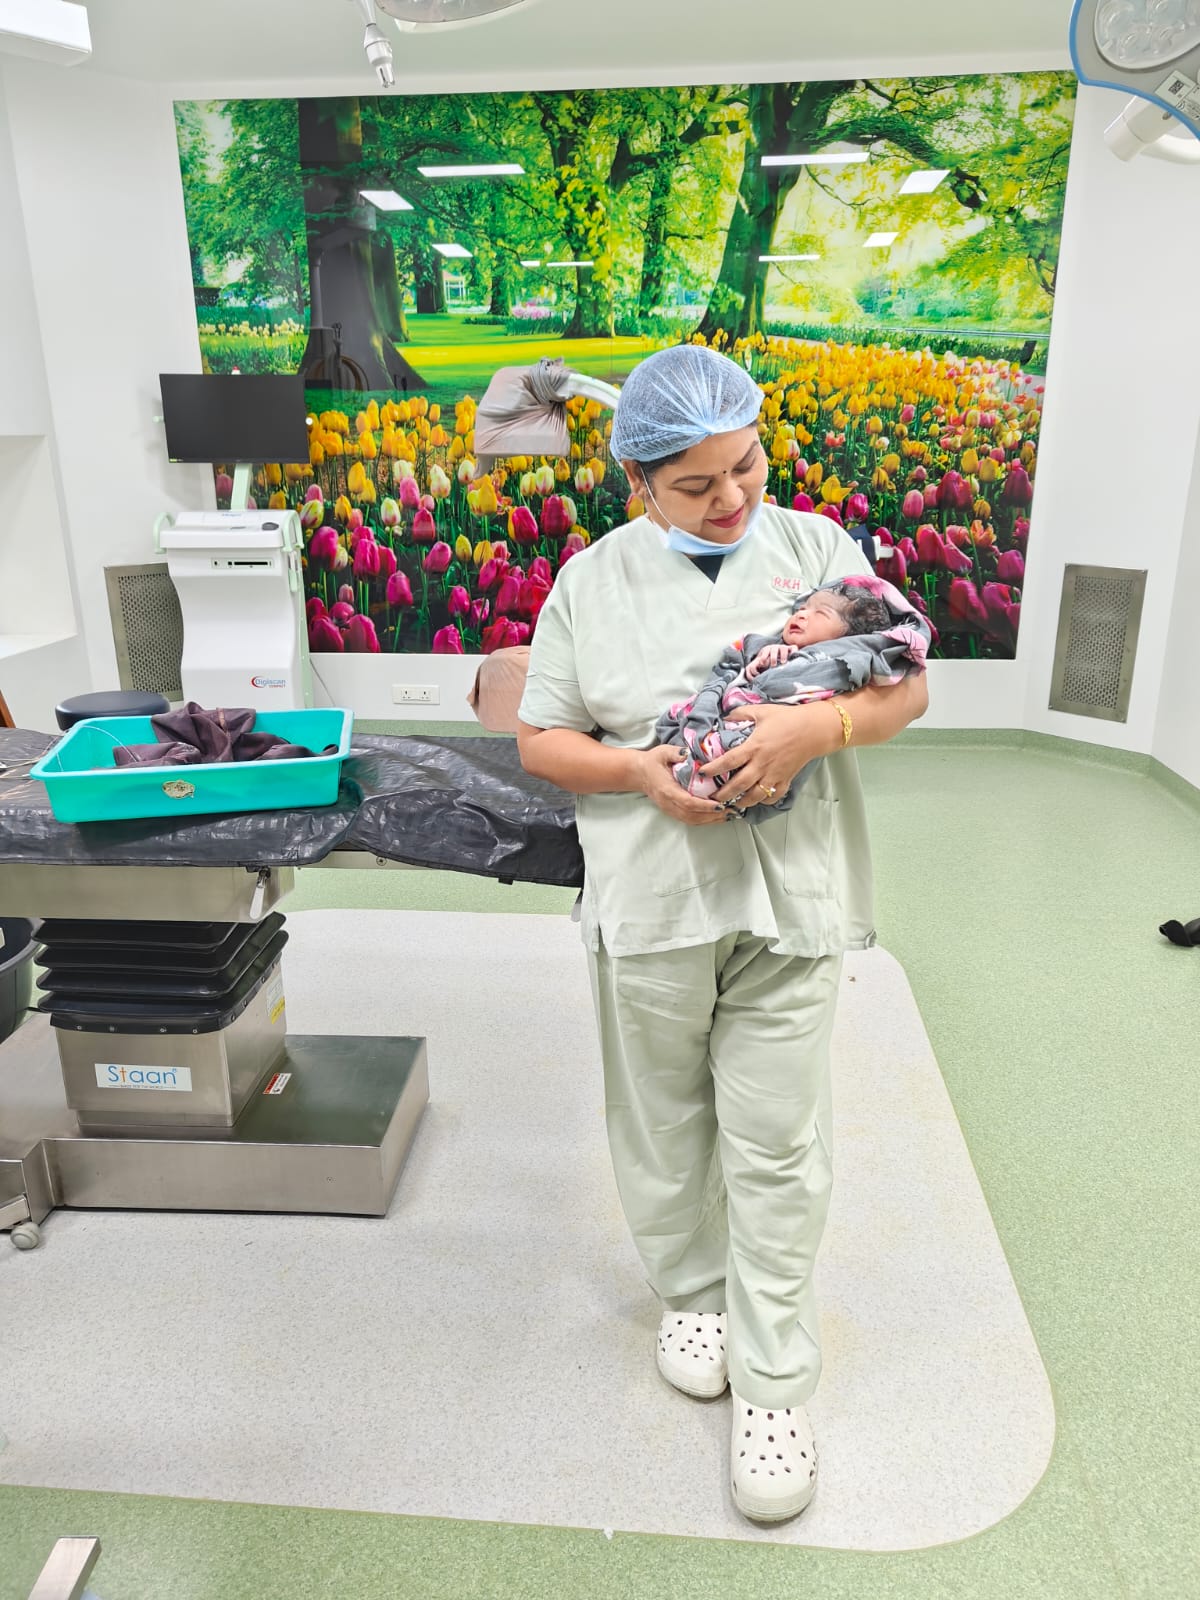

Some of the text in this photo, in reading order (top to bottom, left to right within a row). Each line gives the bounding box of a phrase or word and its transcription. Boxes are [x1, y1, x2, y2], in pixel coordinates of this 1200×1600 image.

[774, 576, 800, 591] RKH
[255, 678, 286, 687] Digiscan
[107, 1065, 176, 1085] Staan
